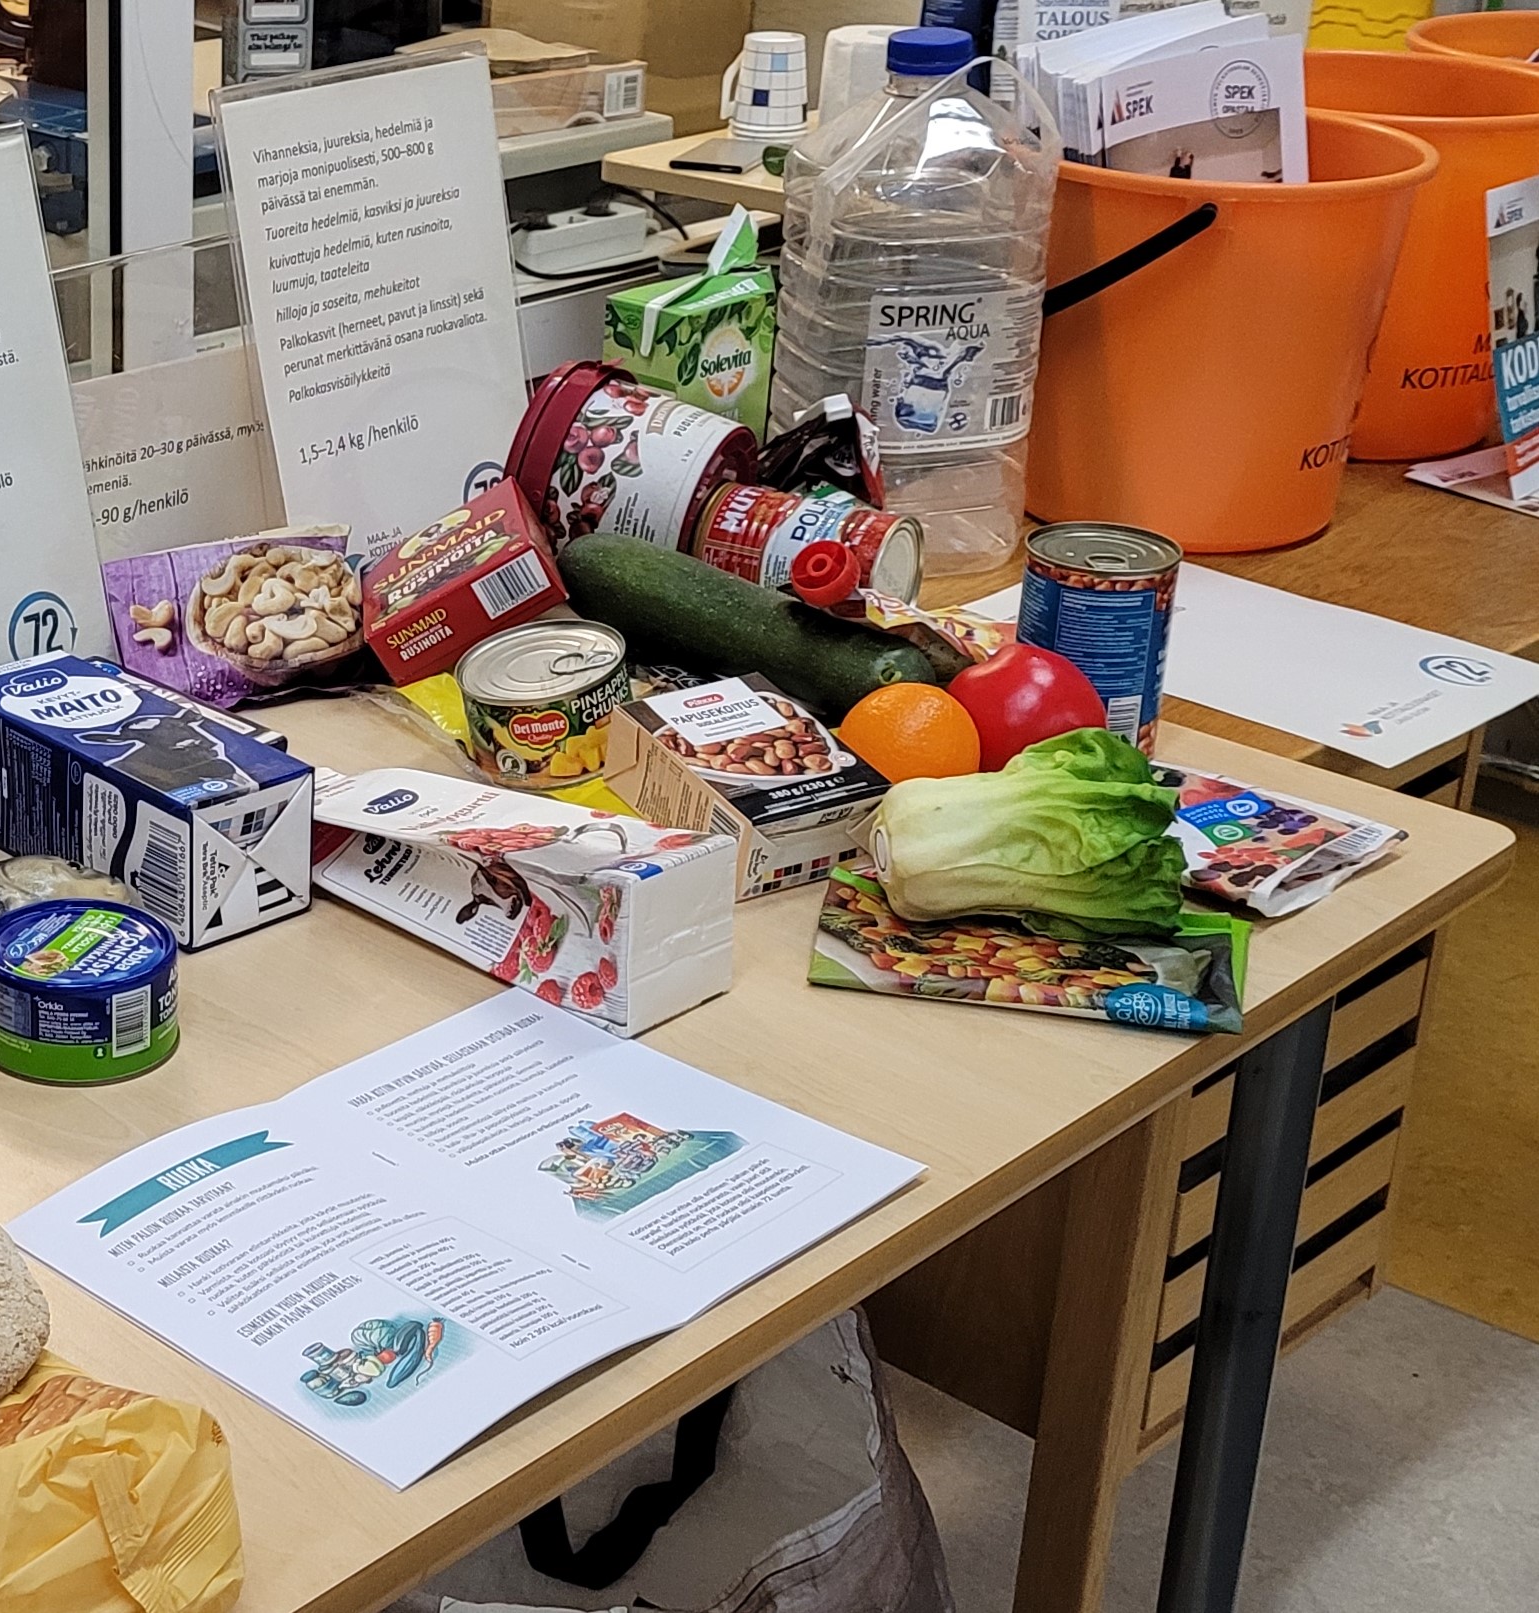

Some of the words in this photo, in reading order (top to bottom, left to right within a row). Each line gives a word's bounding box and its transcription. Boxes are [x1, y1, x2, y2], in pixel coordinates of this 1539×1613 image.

[1035, 10, 1109, 27] TALOUS
[1224, 85, 1256, 101] SPEK
[252, 139, 322, 164] Vihanneksia,
[322, 129, 374, 154] juureksia,
[374, 118, 423, 140] hedelmiä
[423, 116, 434, 133] ja
[260, 190, 306, 216] päivässä
[307, 186, 322, 202] tai
[323, 176, 379, 199] enemmän.
[879, 301, 976, 328] SPRING
[945, 323, 991, 342] AQUA
[700, 349, 752, 379] Solevita
[1501, 337, 1539, 390] KOD
[872, 368, 883, 398] water
[299, 435, 347, 465] 1,5–2,4
[347, 432, 365, 451] kg
[367, 414, 419, 447] /henkilö
[372, 508, 506, 596] SUN-MAID
[387, 528, 498, 606] RUSINOITA
[386, 608, 447, 650] SUN-MAID
[399, 625, 454, 662] RUSINOITA
[7, 671, 65, 696] Valio
[571, 664, 629, 714] PINEAPPLE
[30, 687, 122, 723] MAITO
[582, 684, 629, 724] CHUNKS
[671, 698, 760, 726] PAPUSEKOITUS
[514, 722, 533, 735] Del
[533, 718, 566, 734] Monte
[365, 793, 415, 815] Valio
[208, 849, 219, 876] Tetra
[81, 930, 149, 977] TONFISK
[115, 944, 154, 972] Abba
[37, 1000, 64, 1012] Orkla
[156, 1157, 221, 1193] RUOKA
